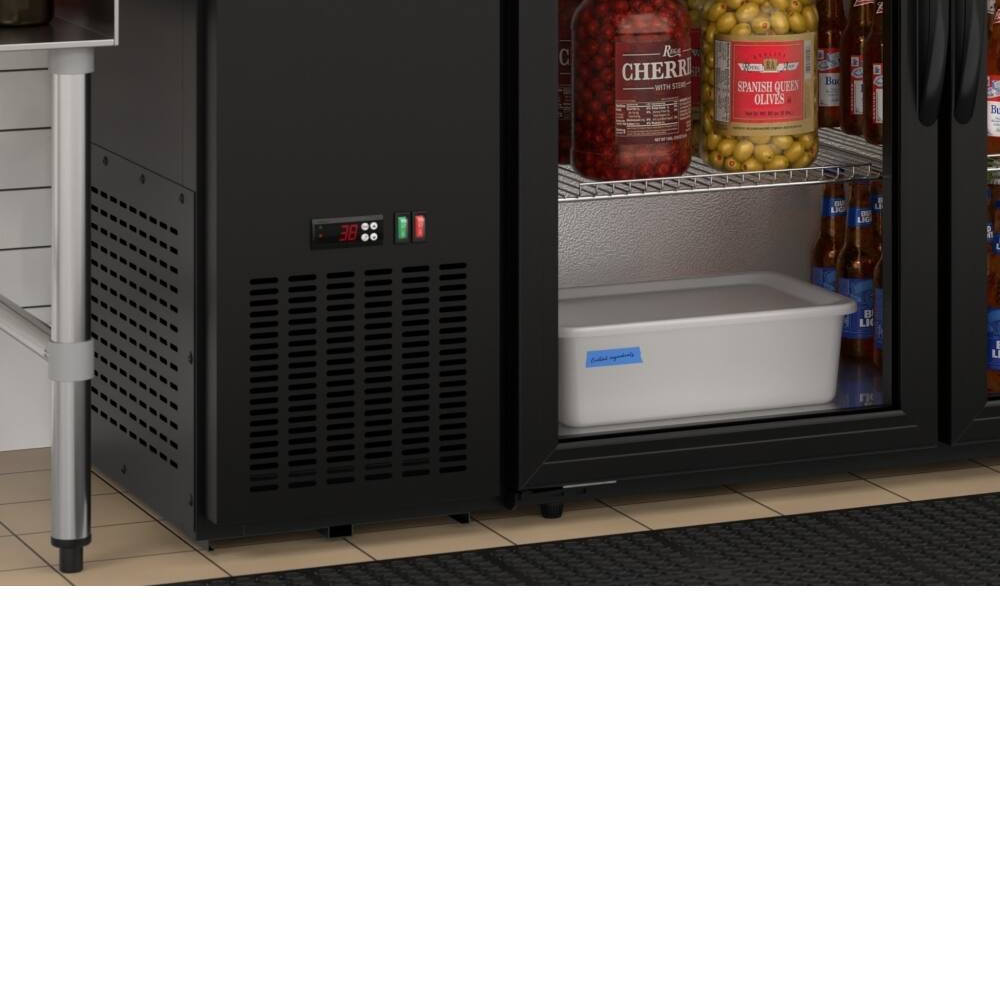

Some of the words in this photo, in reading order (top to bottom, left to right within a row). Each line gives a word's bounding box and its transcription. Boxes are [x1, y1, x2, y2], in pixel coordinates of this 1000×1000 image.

[737, 81, 773, 92] SPANISH
[774, 80, 800, 96] QUEEN
[754, 93, 785, 106] OLIVES
[340, 224, 359, 241] 38
